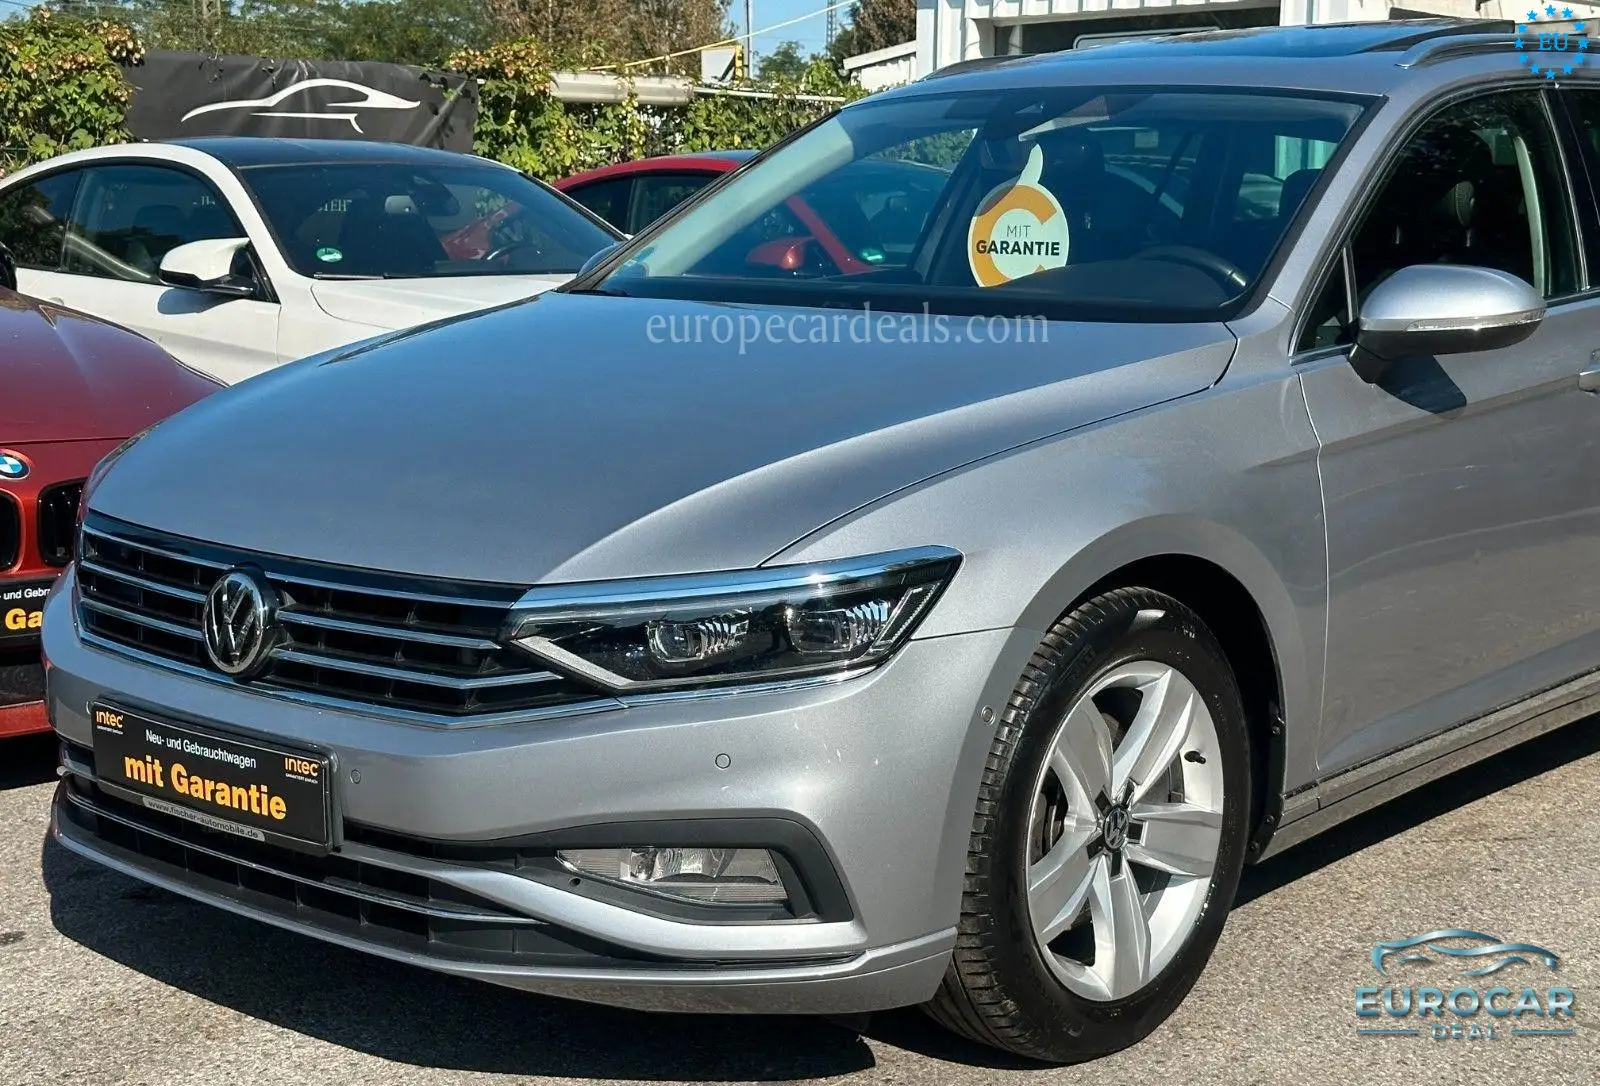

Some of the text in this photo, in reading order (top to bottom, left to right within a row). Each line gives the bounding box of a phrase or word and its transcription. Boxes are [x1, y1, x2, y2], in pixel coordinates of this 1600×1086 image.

[1006, 224, 1031, 238] MIT
[976, 240, 1060, 256] GARANTIE
[3, 589, 22, 600] und
[96, 710, 124, 729] intec
[145, 729, 257, 769] Neu- und Gebrauchtwagen
[284, 757, 318, 777] intec
[124, 755, 287, 820] mit Garantie
[148, 801, 259, 839] www.fischer-automobile.de
